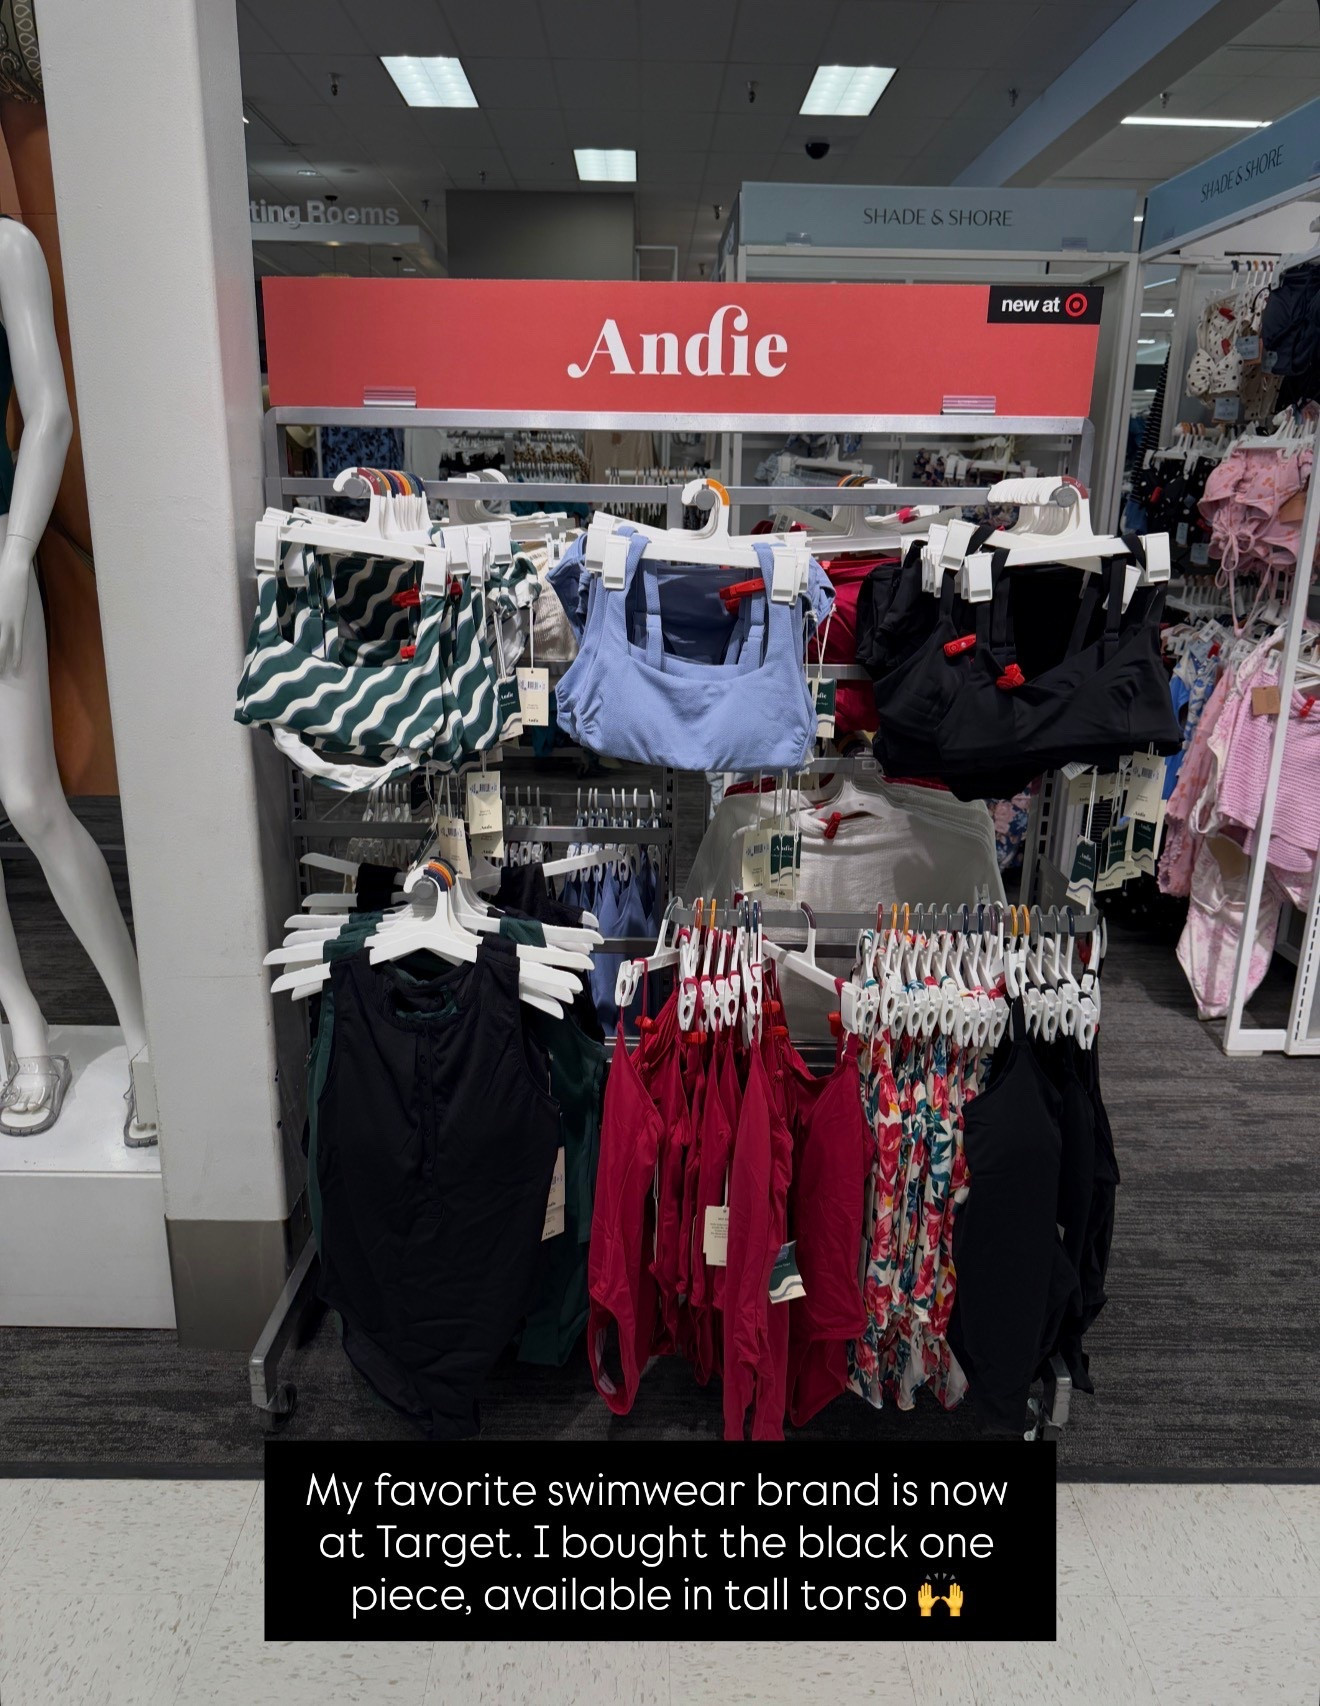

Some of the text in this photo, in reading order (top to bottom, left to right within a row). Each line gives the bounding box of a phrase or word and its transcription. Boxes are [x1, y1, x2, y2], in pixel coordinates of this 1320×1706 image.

[1200, 144, 1284, 203] SHADE & SHORE
[307, 199, 400, 226] Rooms
[863, 207, 1013, 227] SHADE & SHORE
[1001, 296, 1061, 313] new at
[567, 304, 788, 379] Andie
